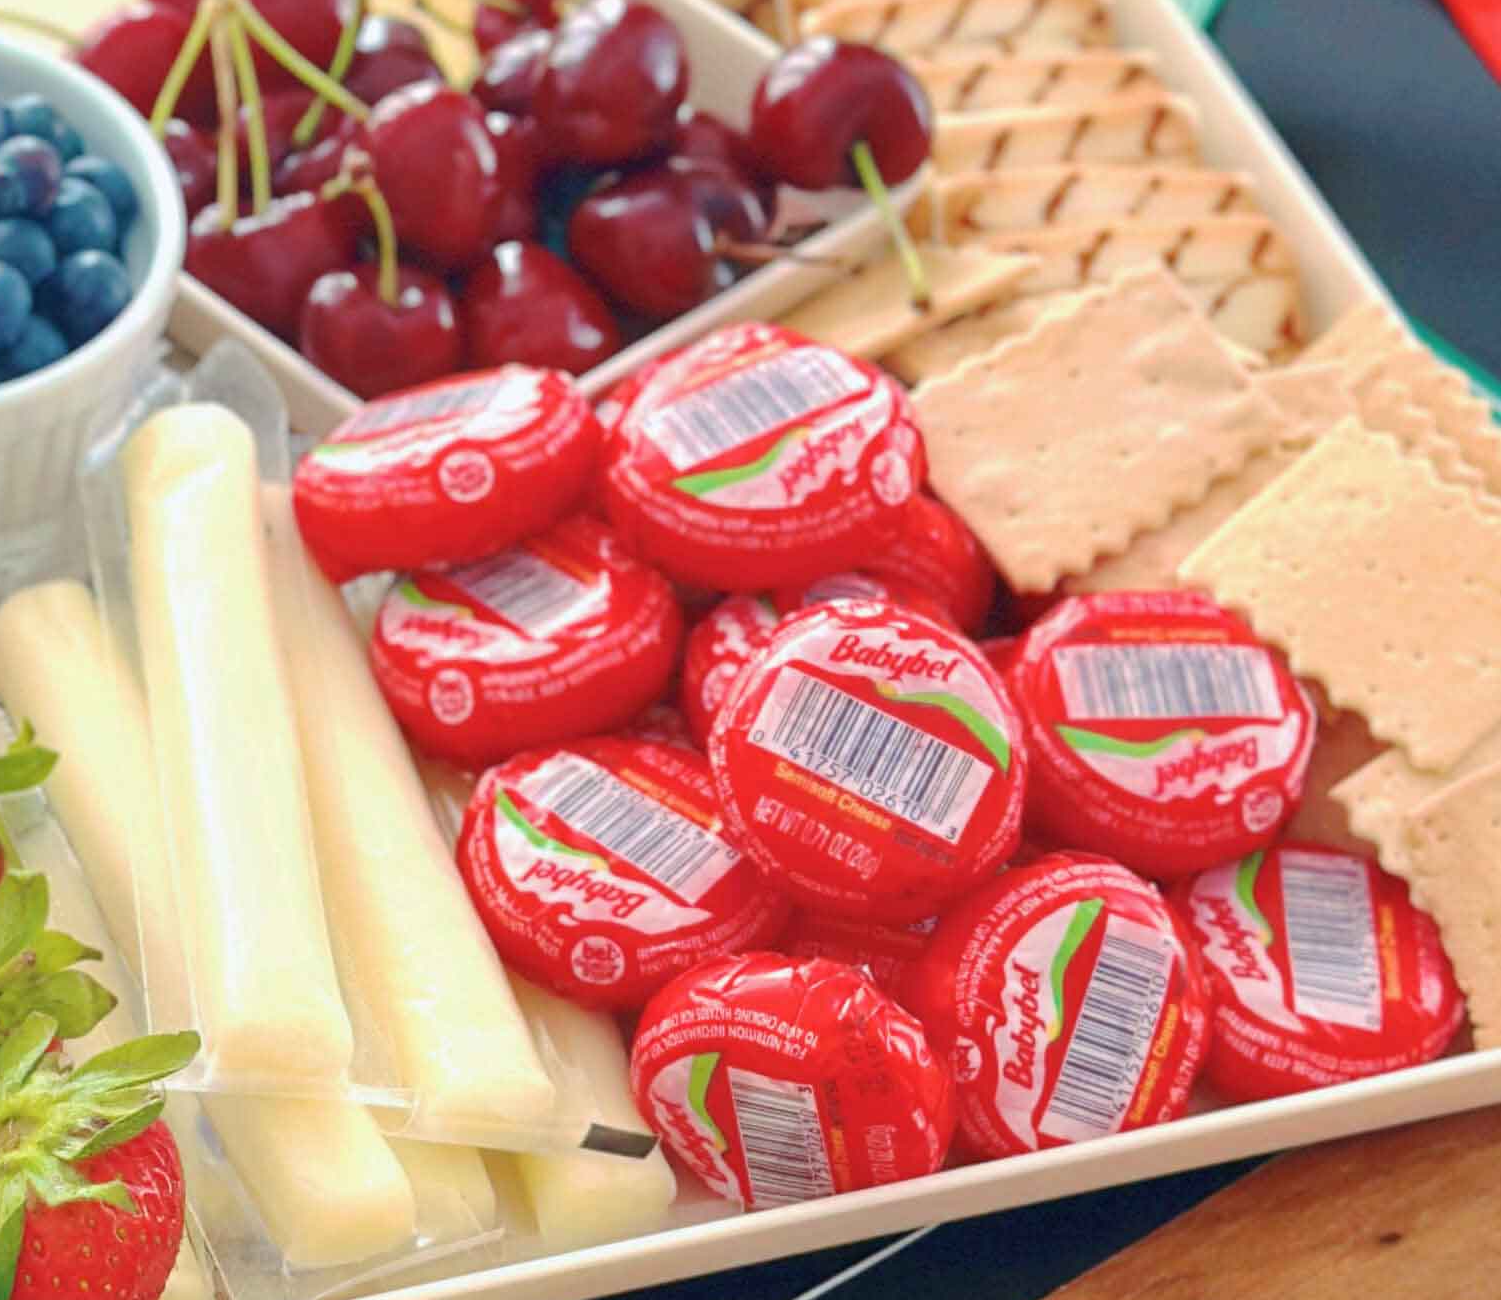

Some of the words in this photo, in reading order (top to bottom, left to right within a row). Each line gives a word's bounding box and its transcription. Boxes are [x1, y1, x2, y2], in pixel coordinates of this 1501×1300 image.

[828, 634, 960, 683] Babybel
[789, 746, 853, 785] 41757
[518, 859, 650, 920] Babybel
[1003, 959, 1049, 1091] Babybel
